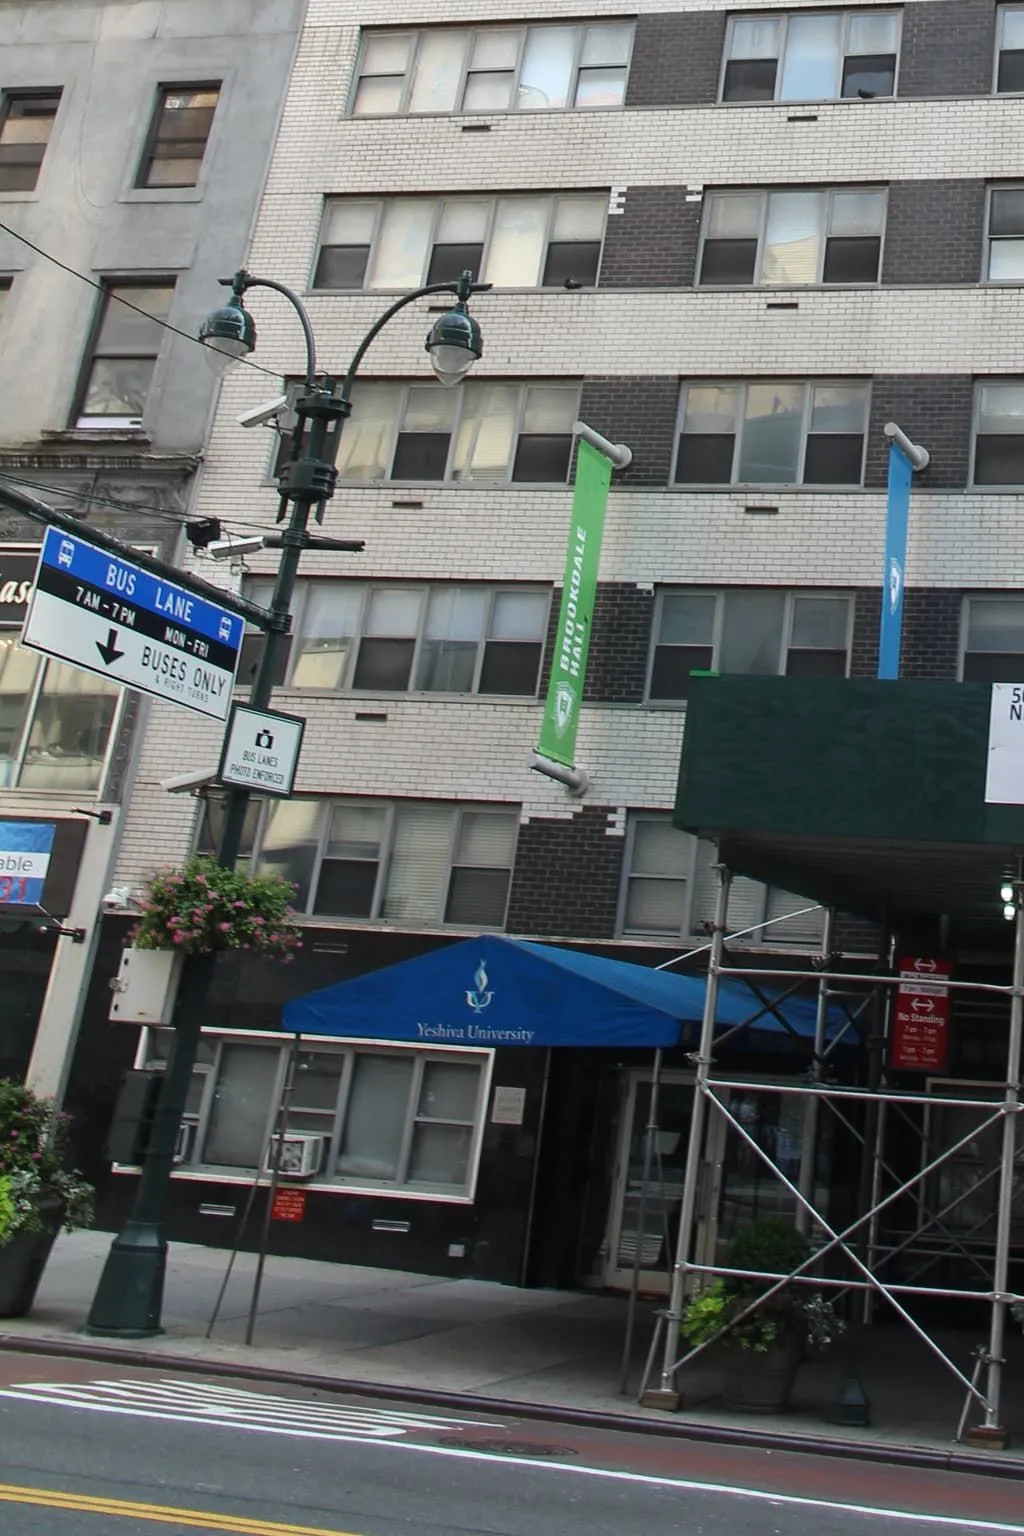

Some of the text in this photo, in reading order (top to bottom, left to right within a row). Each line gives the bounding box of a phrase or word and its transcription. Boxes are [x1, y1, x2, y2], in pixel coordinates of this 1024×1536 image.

[106, 564, 195, 622] BUS LANE
[560, 525, 587, 671] BROOKDALE
[142, 646, 227, 697] BUSES ONLY
[569, 622, 585, 677] HALL
[230, 763, 285, 785] PHOTO ENFORCED
[242, 750, 280, 768] BUS LANES
[416, 1022, 536, 1044] Yeshiva University
